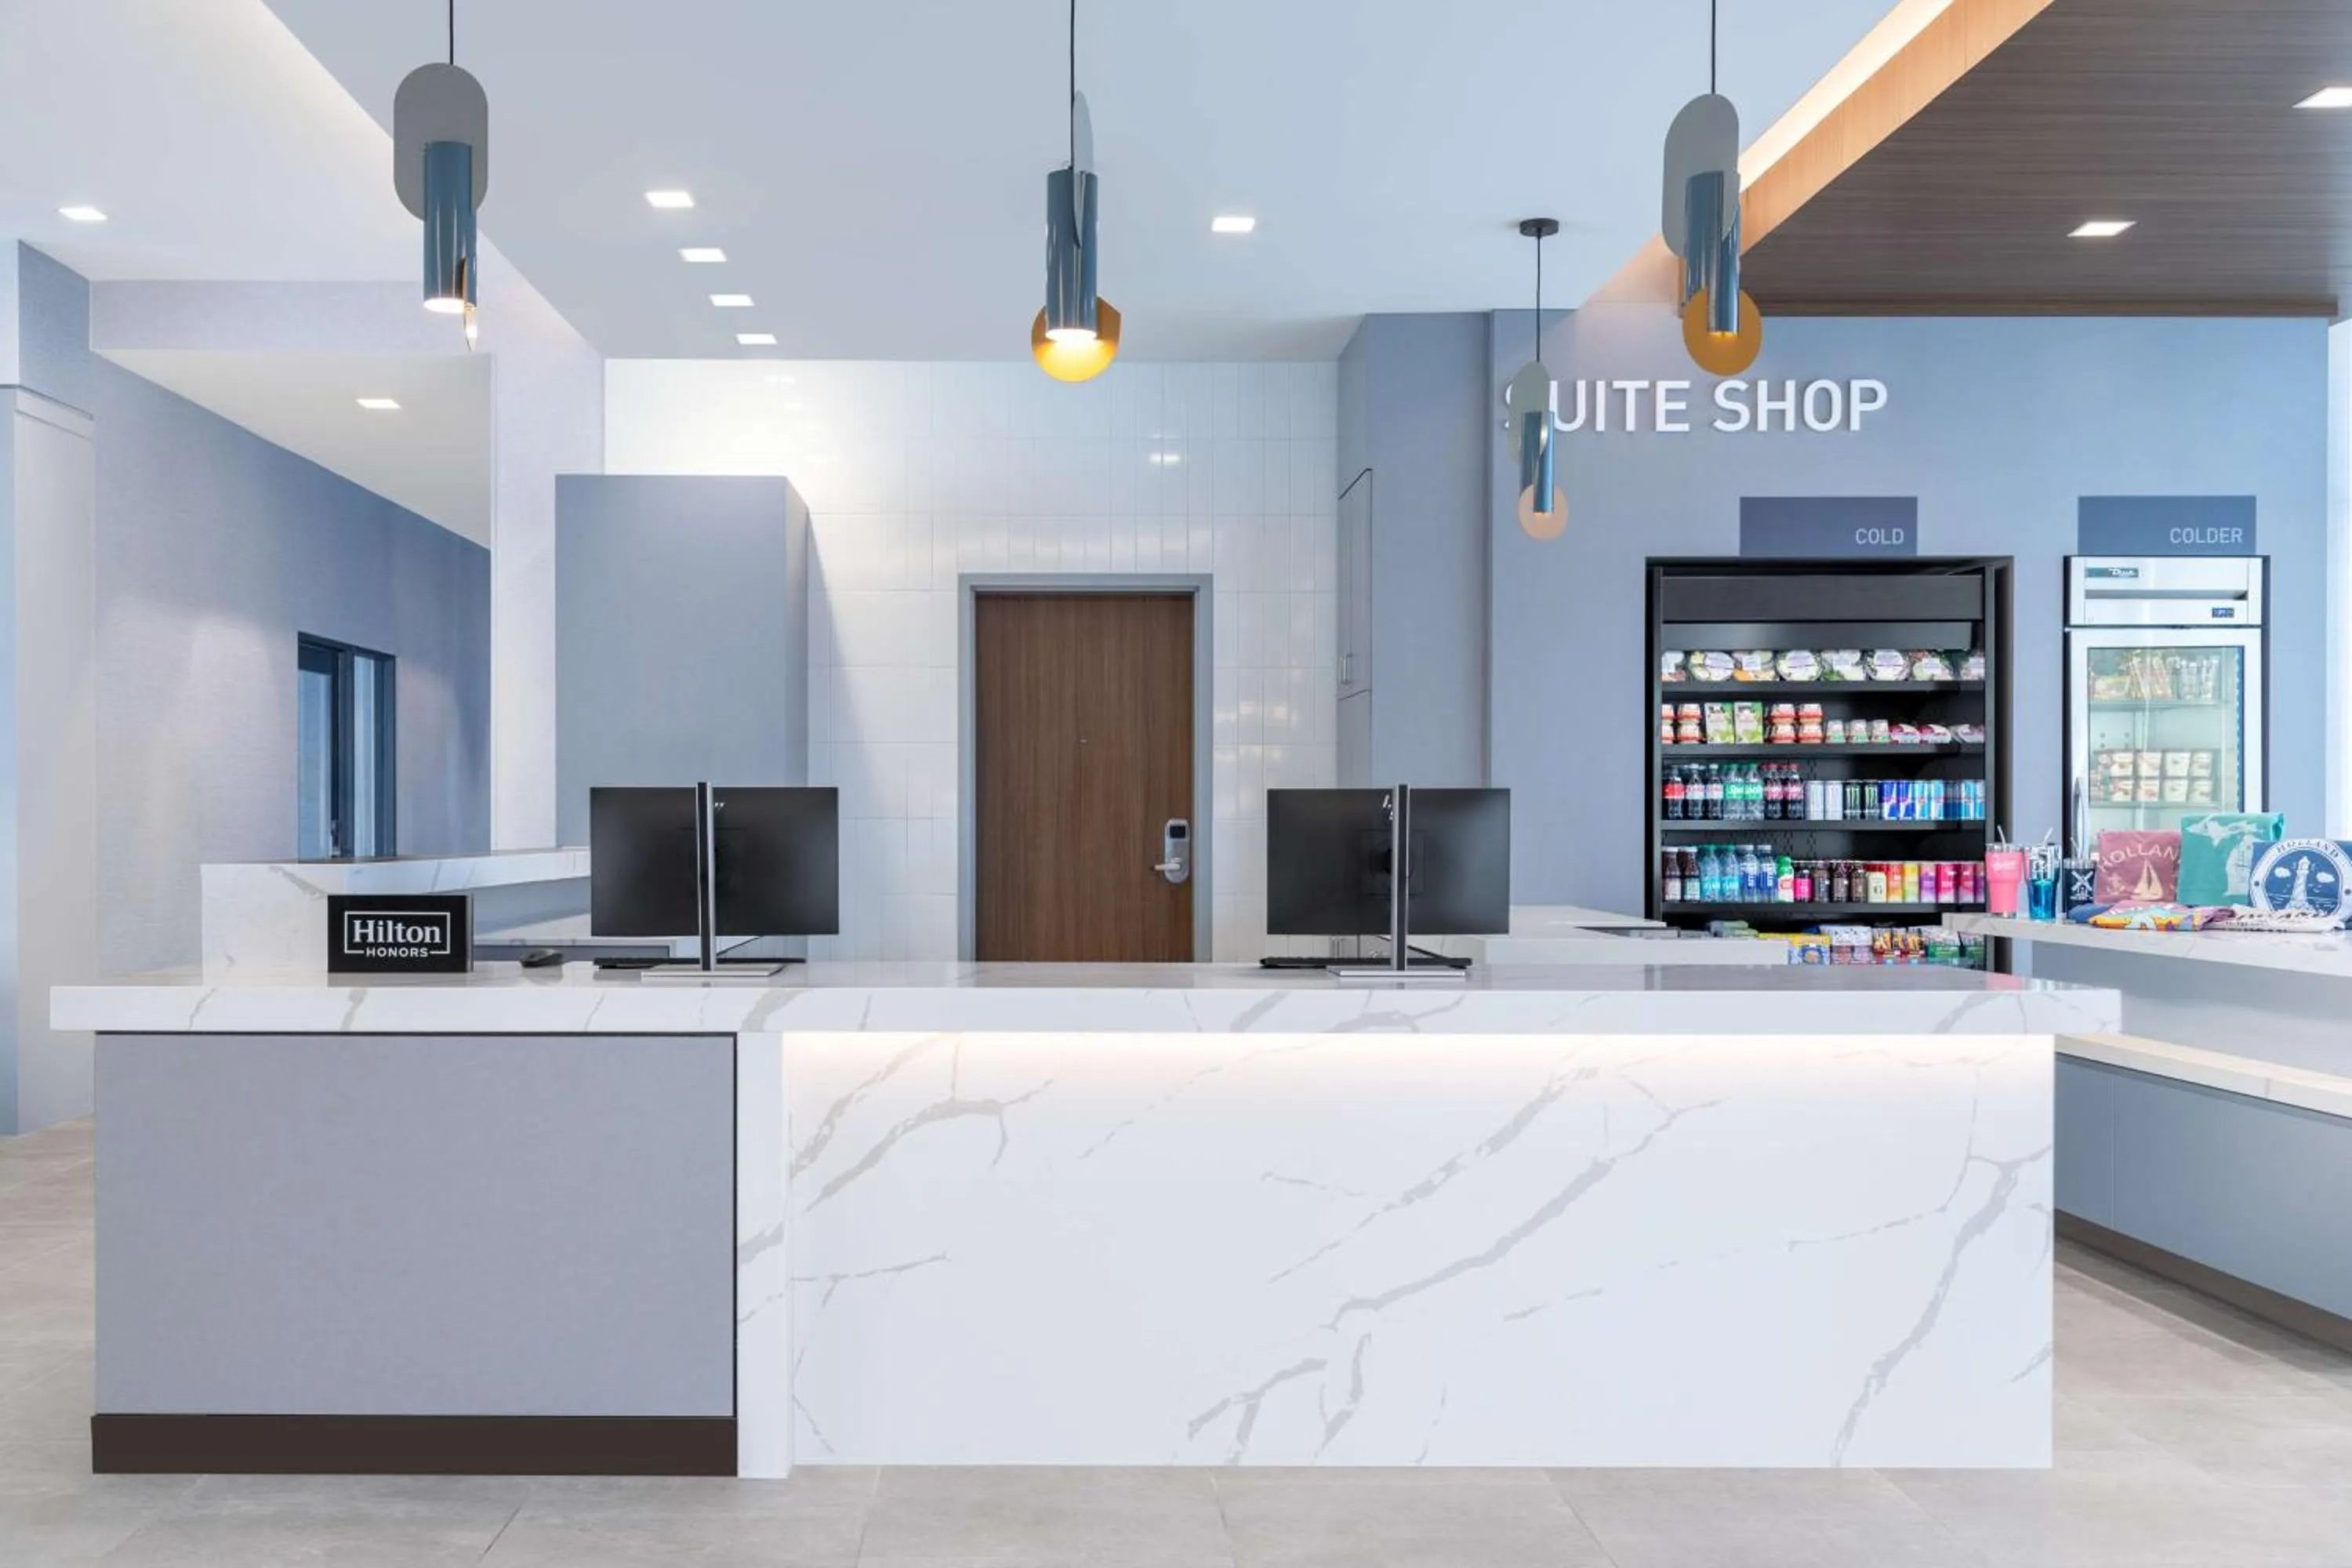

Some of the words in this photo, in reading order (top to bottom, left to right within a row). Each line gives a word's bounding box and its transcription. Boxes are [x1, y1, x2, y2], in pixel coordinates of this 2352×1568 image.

[1504, 379, 1691, 432] UITE
[1713, 379, 1888, 432] SHOP
[1855, 528, 1904, 545] COLD
[2169, 527, 2243, 544] COLDER
[2098, 843, 2180, 873] HOLLAN
[353, 920, 441, 944] Hilton
[365, 947, 429, 957] HONORS
